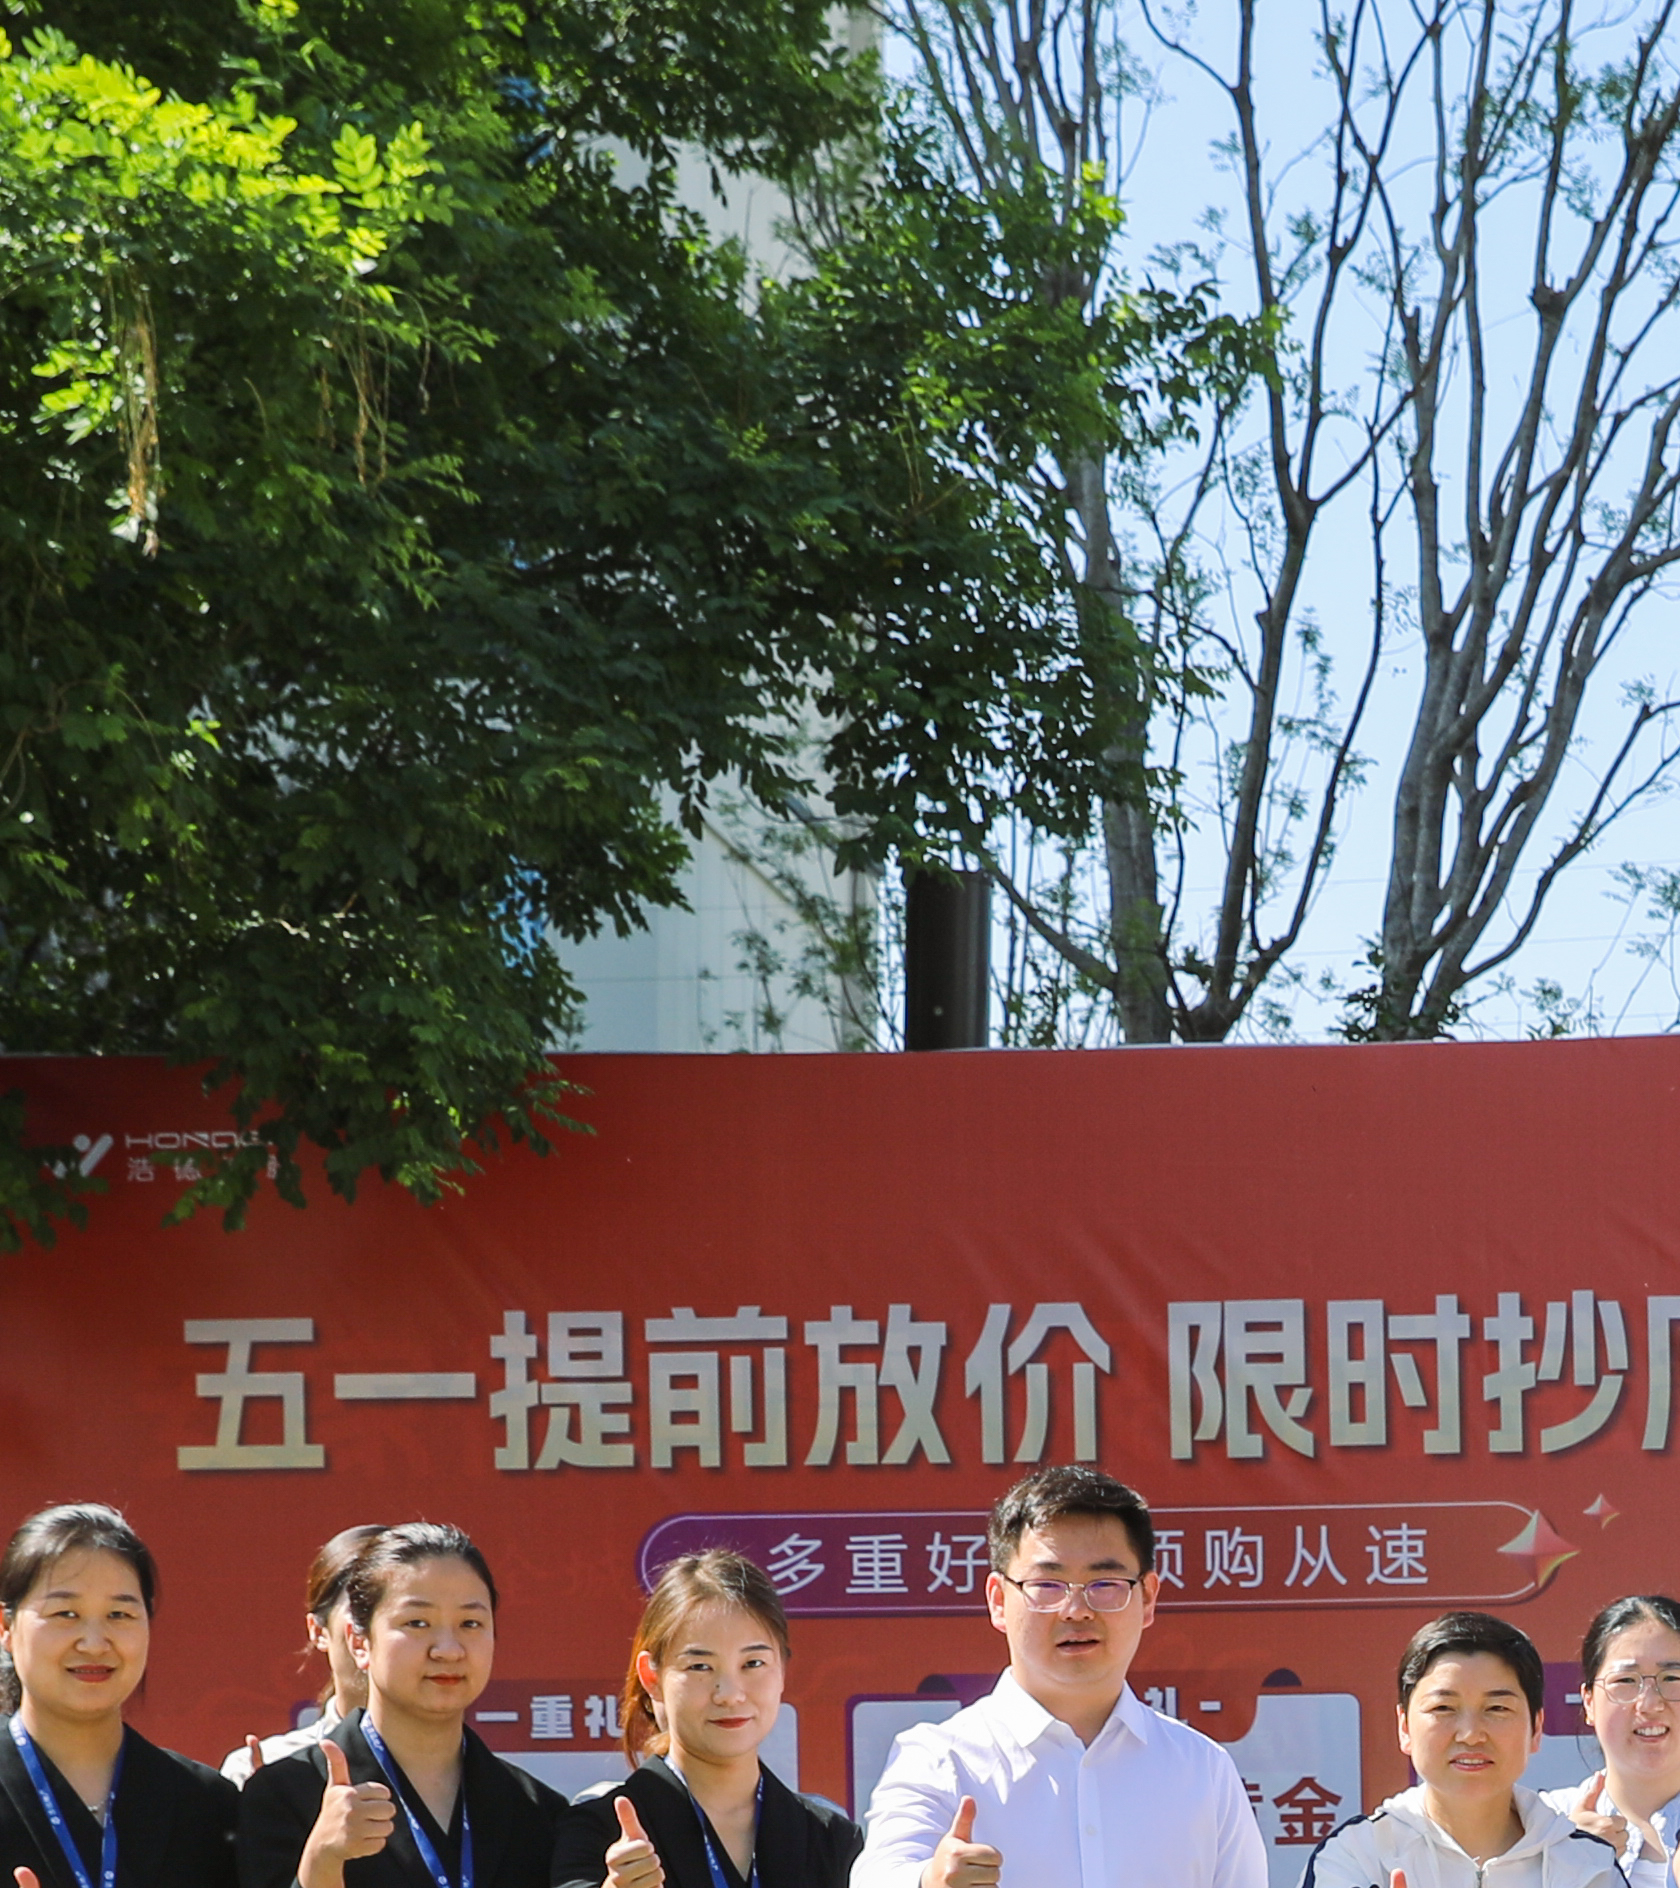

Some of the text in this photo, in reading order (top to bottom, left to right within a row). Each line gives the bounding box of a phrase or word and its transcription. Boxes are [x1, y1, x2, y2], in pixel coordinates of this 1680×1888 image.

[175, 1300, 1111, 1473] 五一提前放价
